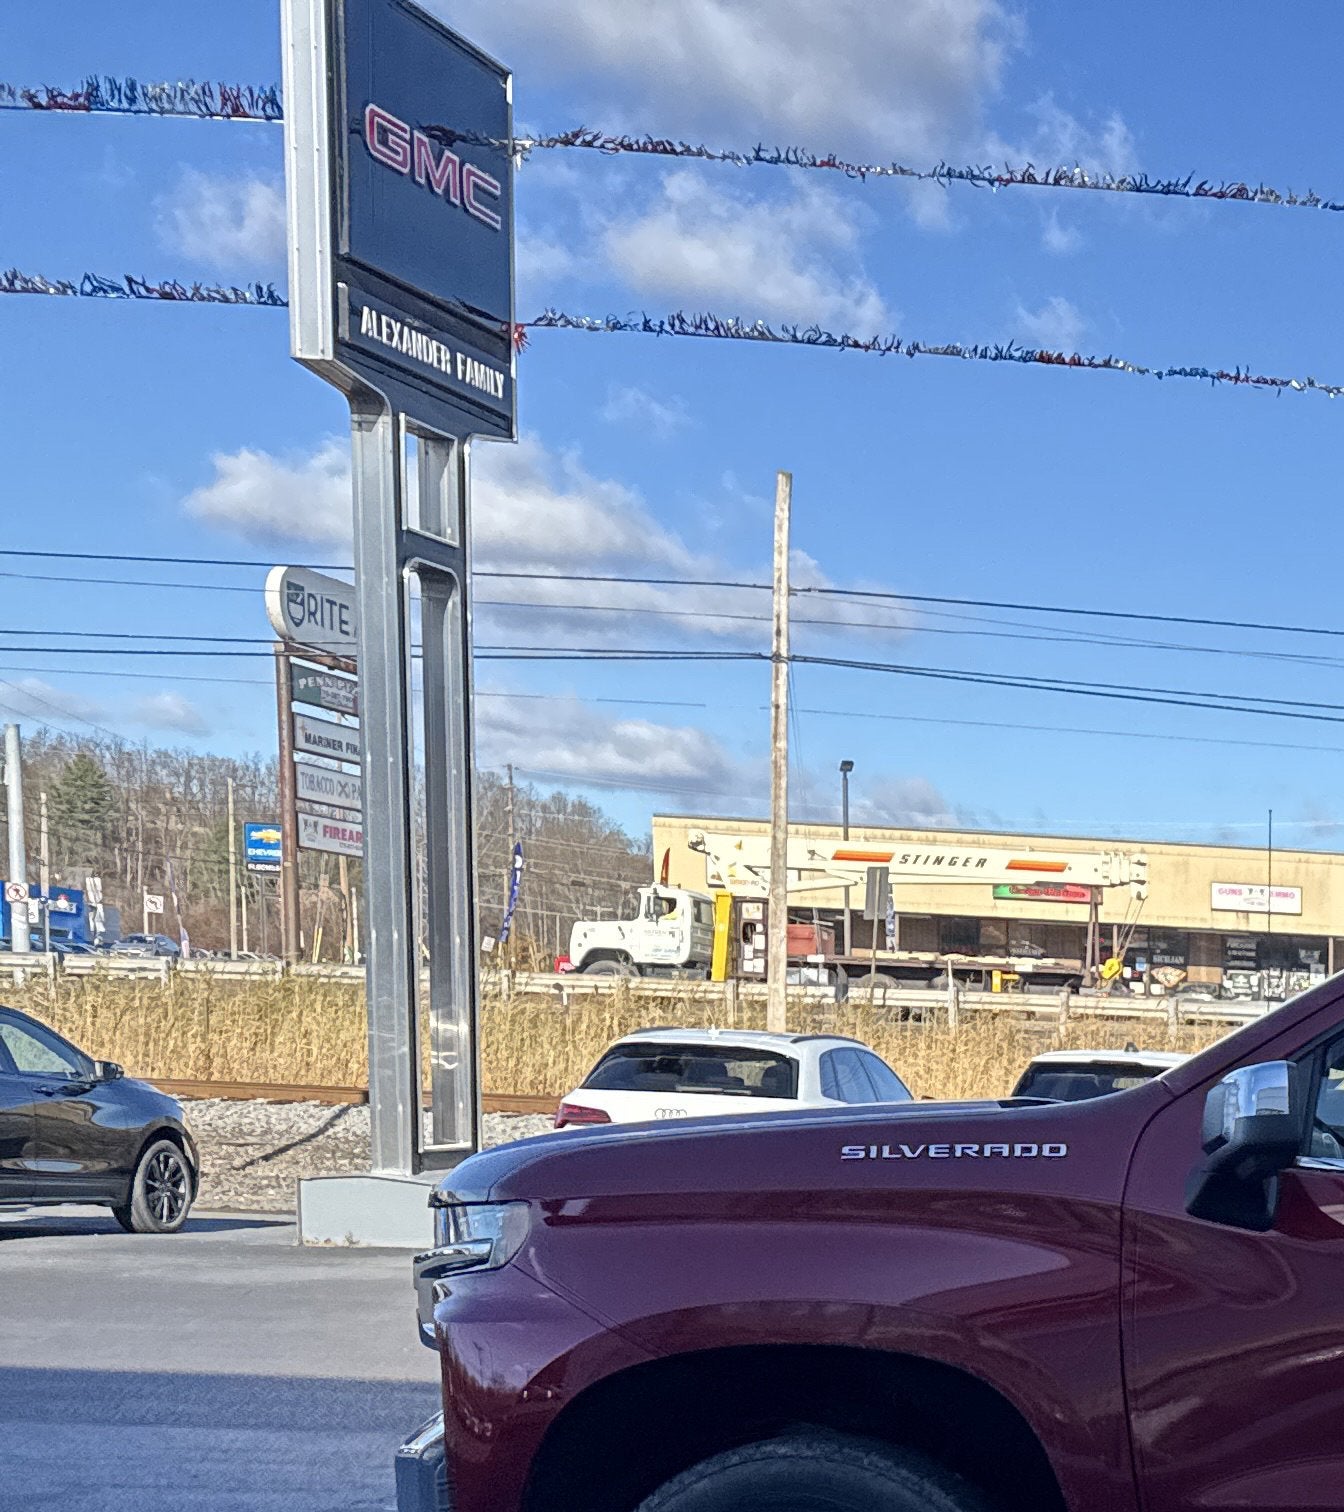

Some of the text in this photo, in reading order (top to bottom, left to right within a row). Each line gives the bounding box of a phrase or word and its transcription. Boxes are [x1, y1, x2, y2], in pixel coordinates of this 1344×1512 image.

[366, 103, 501, 231] GMC
[360, 305, 504, 398] ALEXANDER FAMILY
[307, 592, 350, 637] RITE
[304, 732, 343, 753] MARINER
[300, 771, 335, 796] TOBACCO
[899, 854, 988, 868] STINGER
[841, 1143, 1068, 1160] SILVERADO
